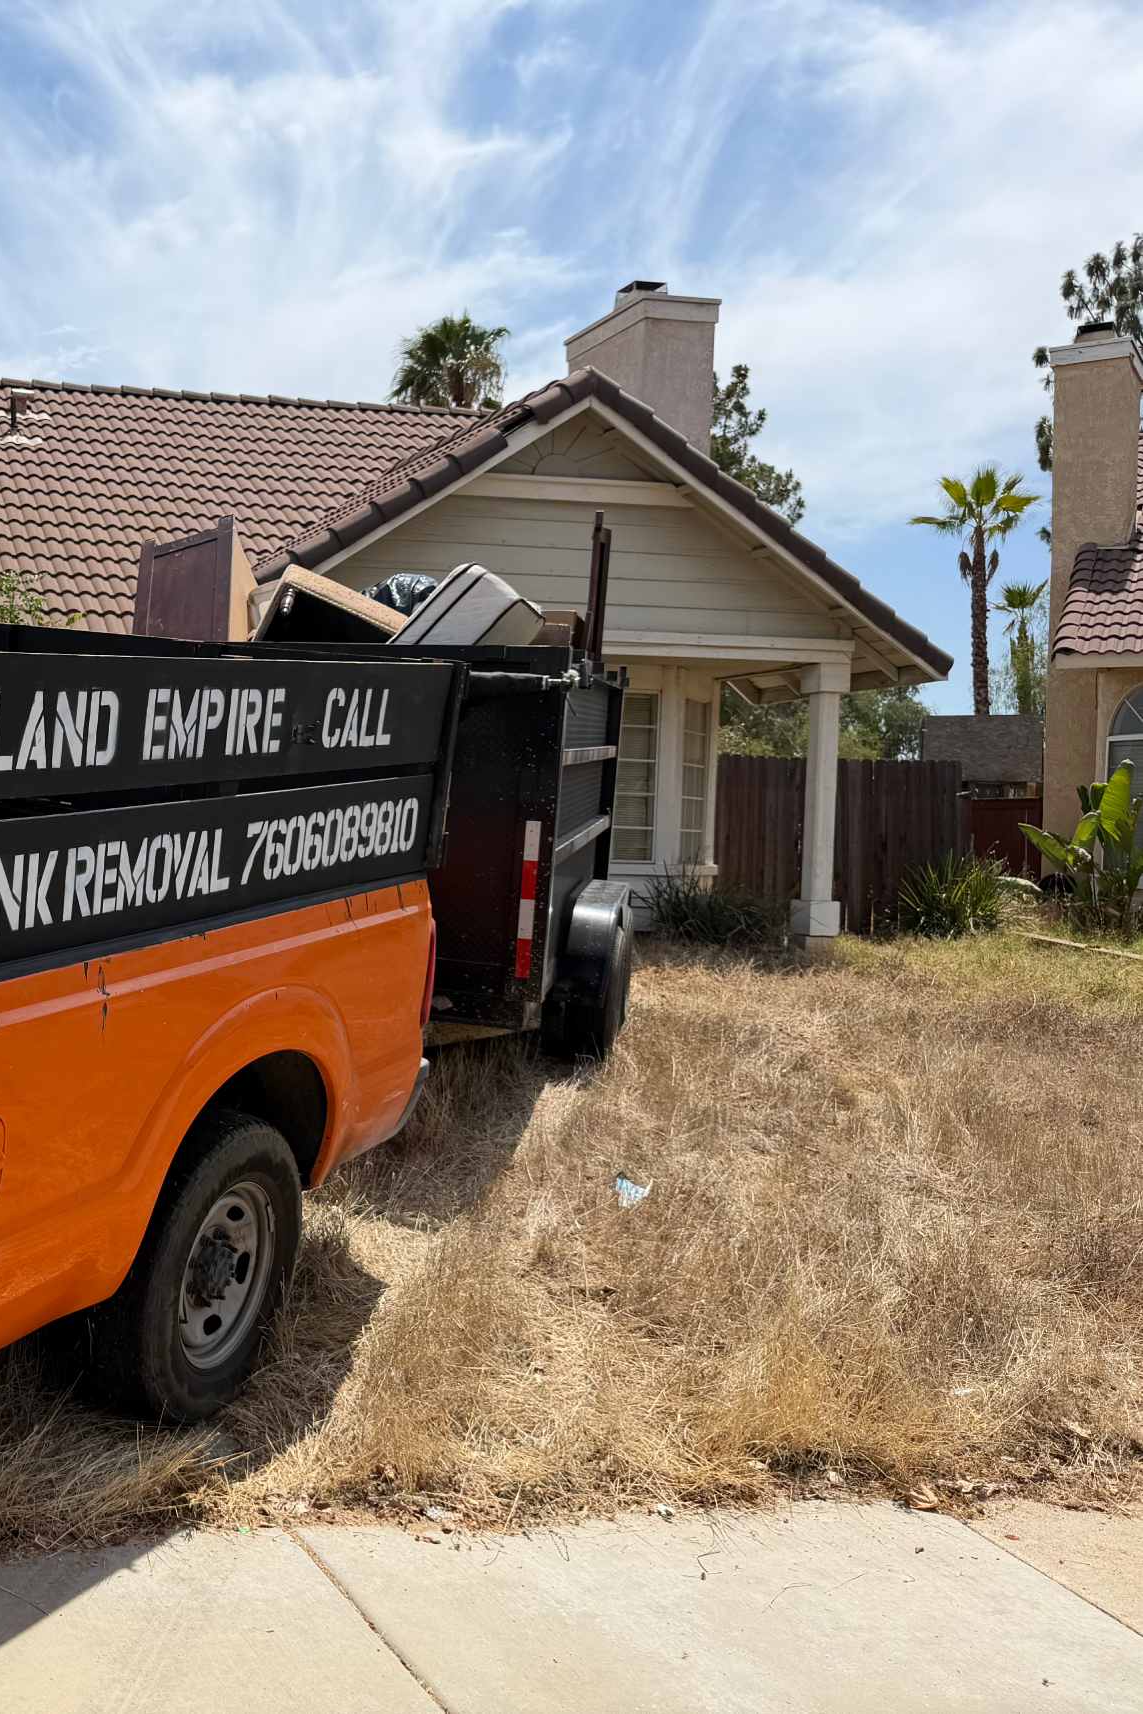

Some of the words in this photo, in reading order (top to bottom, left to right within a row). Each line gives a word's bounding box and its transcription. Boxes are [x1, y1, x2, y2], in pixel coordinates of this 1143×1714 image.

[142, 687, 287, 762] EMPIRE
[321, 687, 392, 748] CALL
[62, 827, 230, 922] REMOVAL
[240, 797, 419, 886] 7606089810
